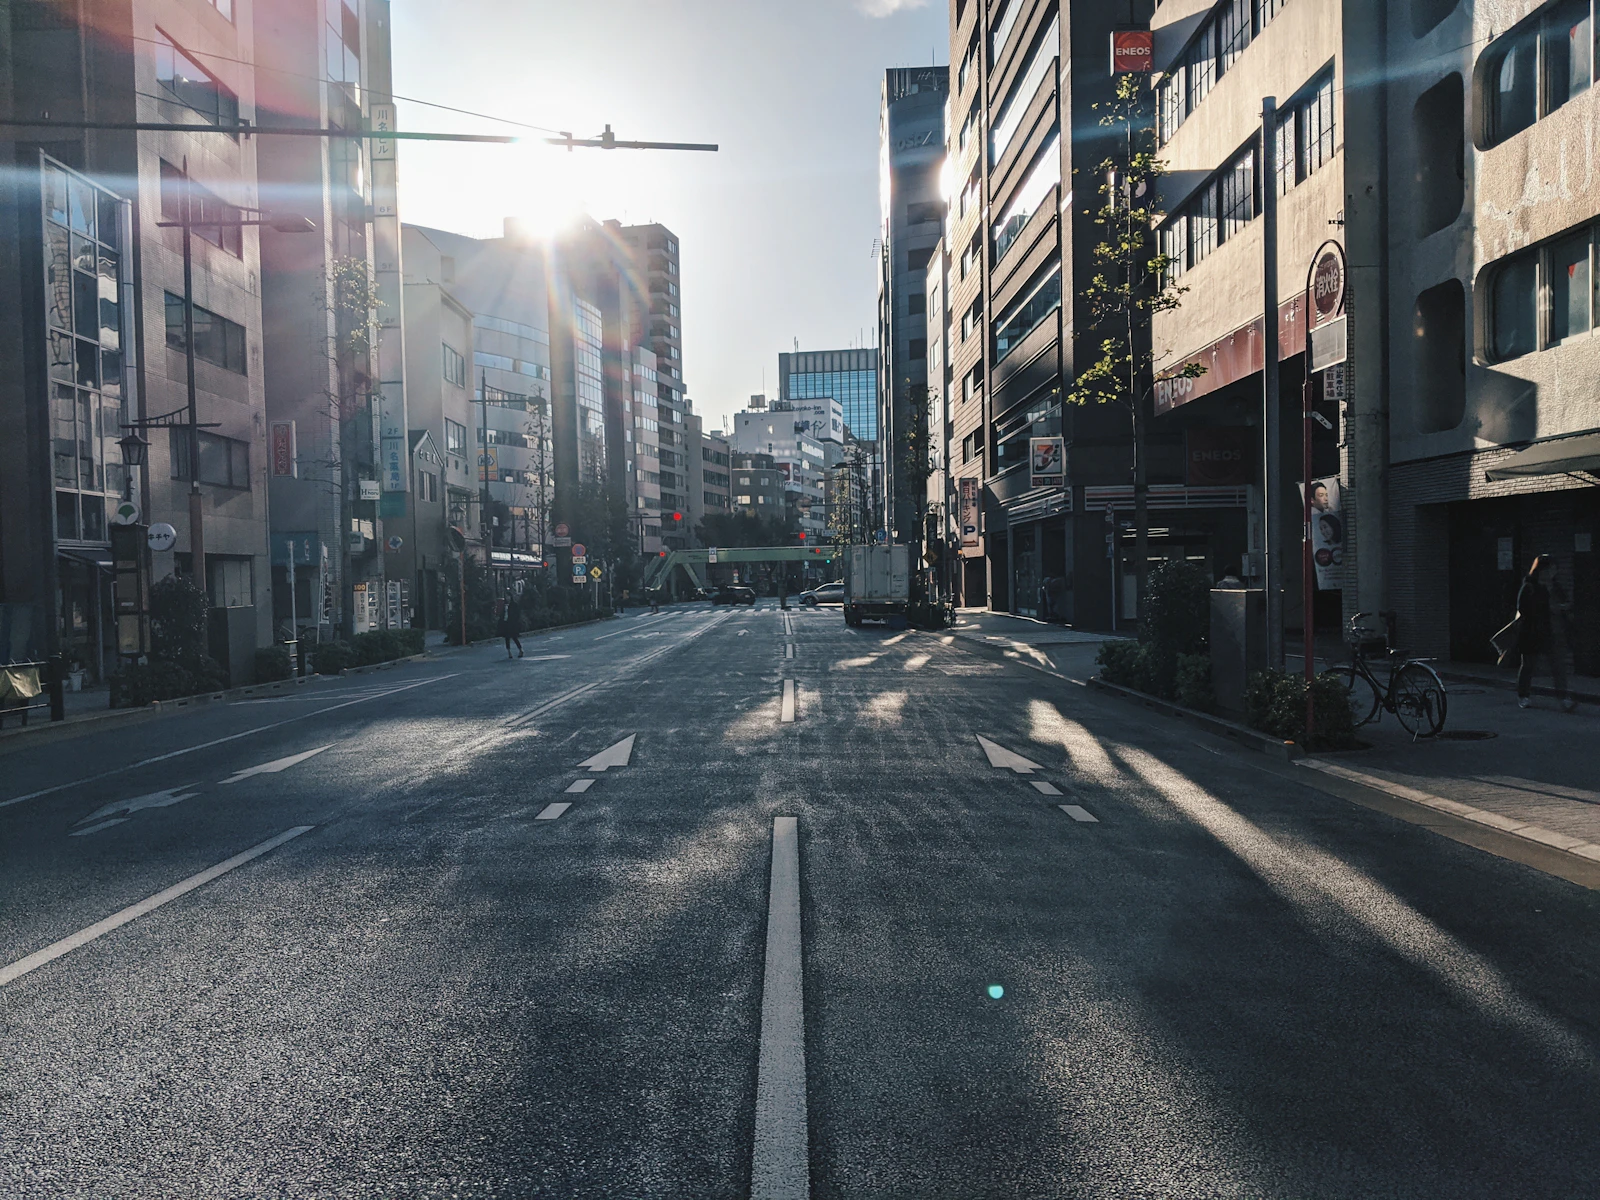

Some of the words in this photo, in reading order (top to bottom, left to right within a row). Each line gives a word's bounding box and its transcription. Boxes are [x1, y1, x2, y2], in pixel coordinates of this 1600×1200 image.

[1116, 47, 1151, 56] ENEOS
[1316, 267, 1339, 299] 消火栓
[1158, 378, 1193, 406] ENEOS
[1192, 449, 1242, 462] ENEOS
[964, 526, 976, 535] P
[575, 566, 582, 575] P
